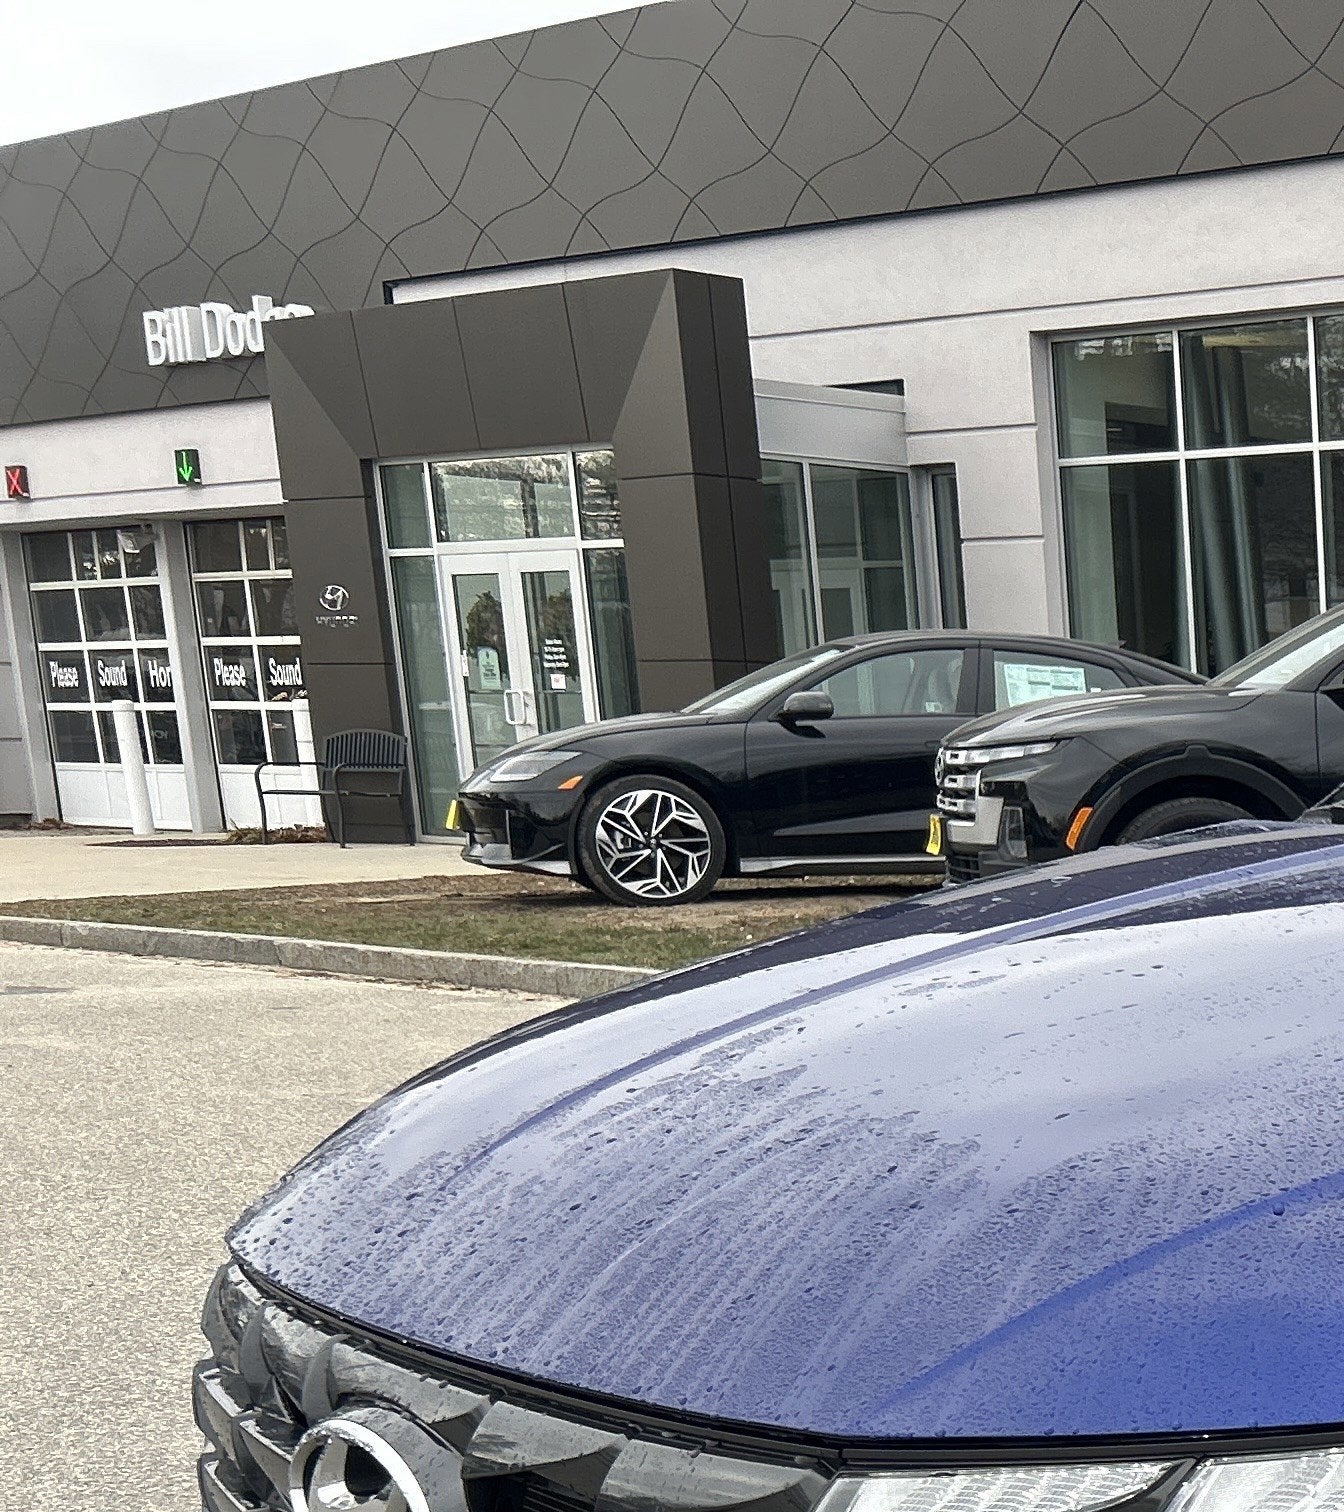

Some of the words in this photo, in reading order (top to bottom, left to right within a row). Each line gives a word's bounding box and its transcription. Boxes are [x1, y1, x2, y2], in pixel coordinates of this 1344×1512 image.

[143, 306, 203, 366] Bill
[200, 294, 315, 359] Dod
[49, 660, 80, 688] Please
[97, 659, 127, 687] Sound
[213, 657, 246, 687] Please
[268, 657, 302, 687] Sound
